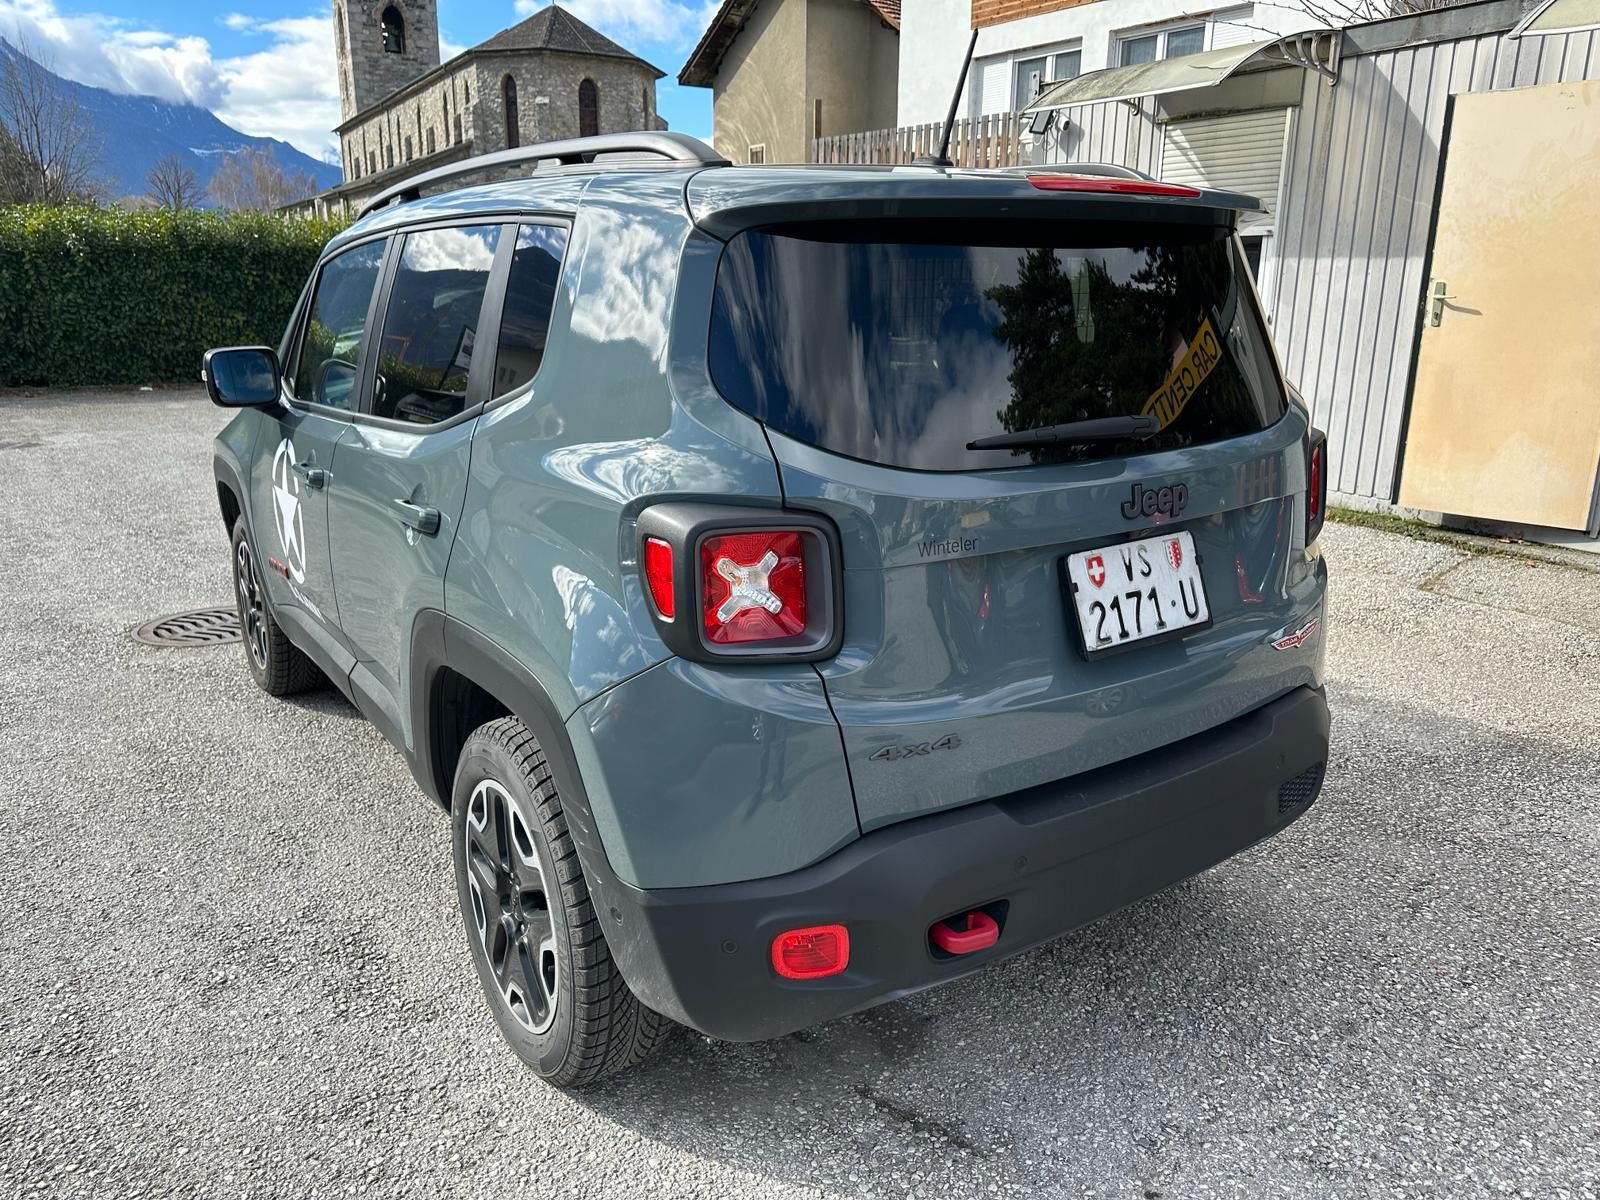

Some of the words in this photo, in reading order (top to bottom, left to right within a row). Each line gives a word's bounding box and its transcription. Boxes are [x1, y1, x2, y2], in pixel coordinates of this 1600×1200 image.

[1121, 483, 1188, 520] Jeep
[918, 536, 979, 557] Winteler
[1119, 544, 1152, 582] VS
